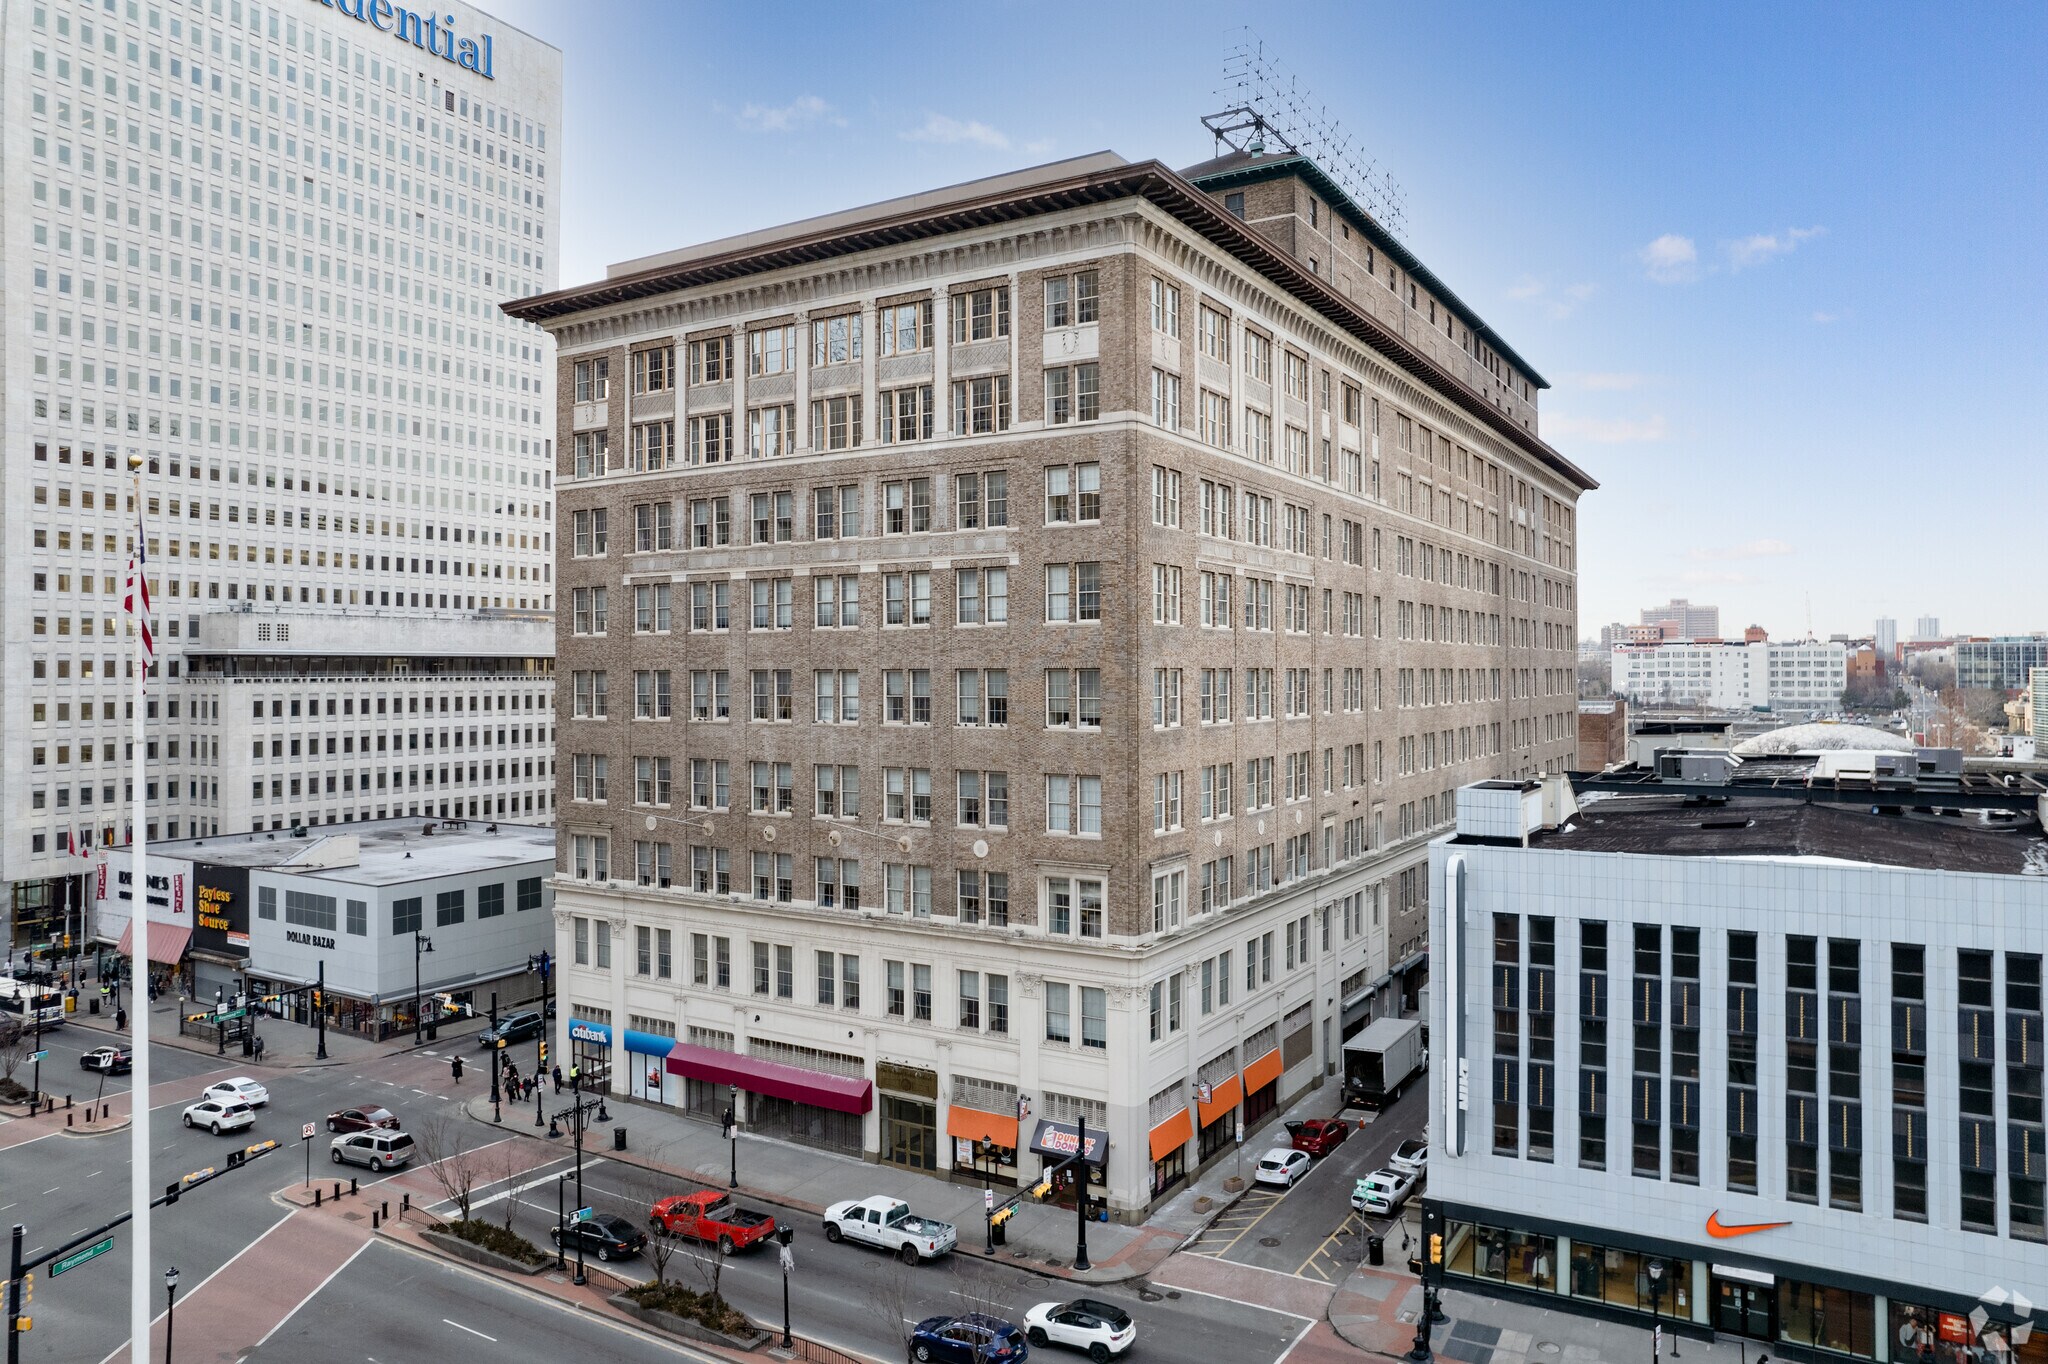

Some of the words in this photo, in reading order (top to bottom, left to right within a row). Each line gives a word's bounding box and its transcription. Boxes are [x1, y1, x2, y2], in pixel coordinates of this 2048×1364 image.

[321, 0, 494, 80] dential
[198, 885, 231, 902] Payless
[198, 899, 221, 914] Shoe
[198, 914, 229, 930] Source
[286, 930, 311, 946] DOLLAR
[312, 935, 336, 950] BAZAR
[571, 1025, 607, 1043] citibank
[1057, 1133, 1096, 1147] DUNN'
[61, 1249, 94, 1269] Raymond
